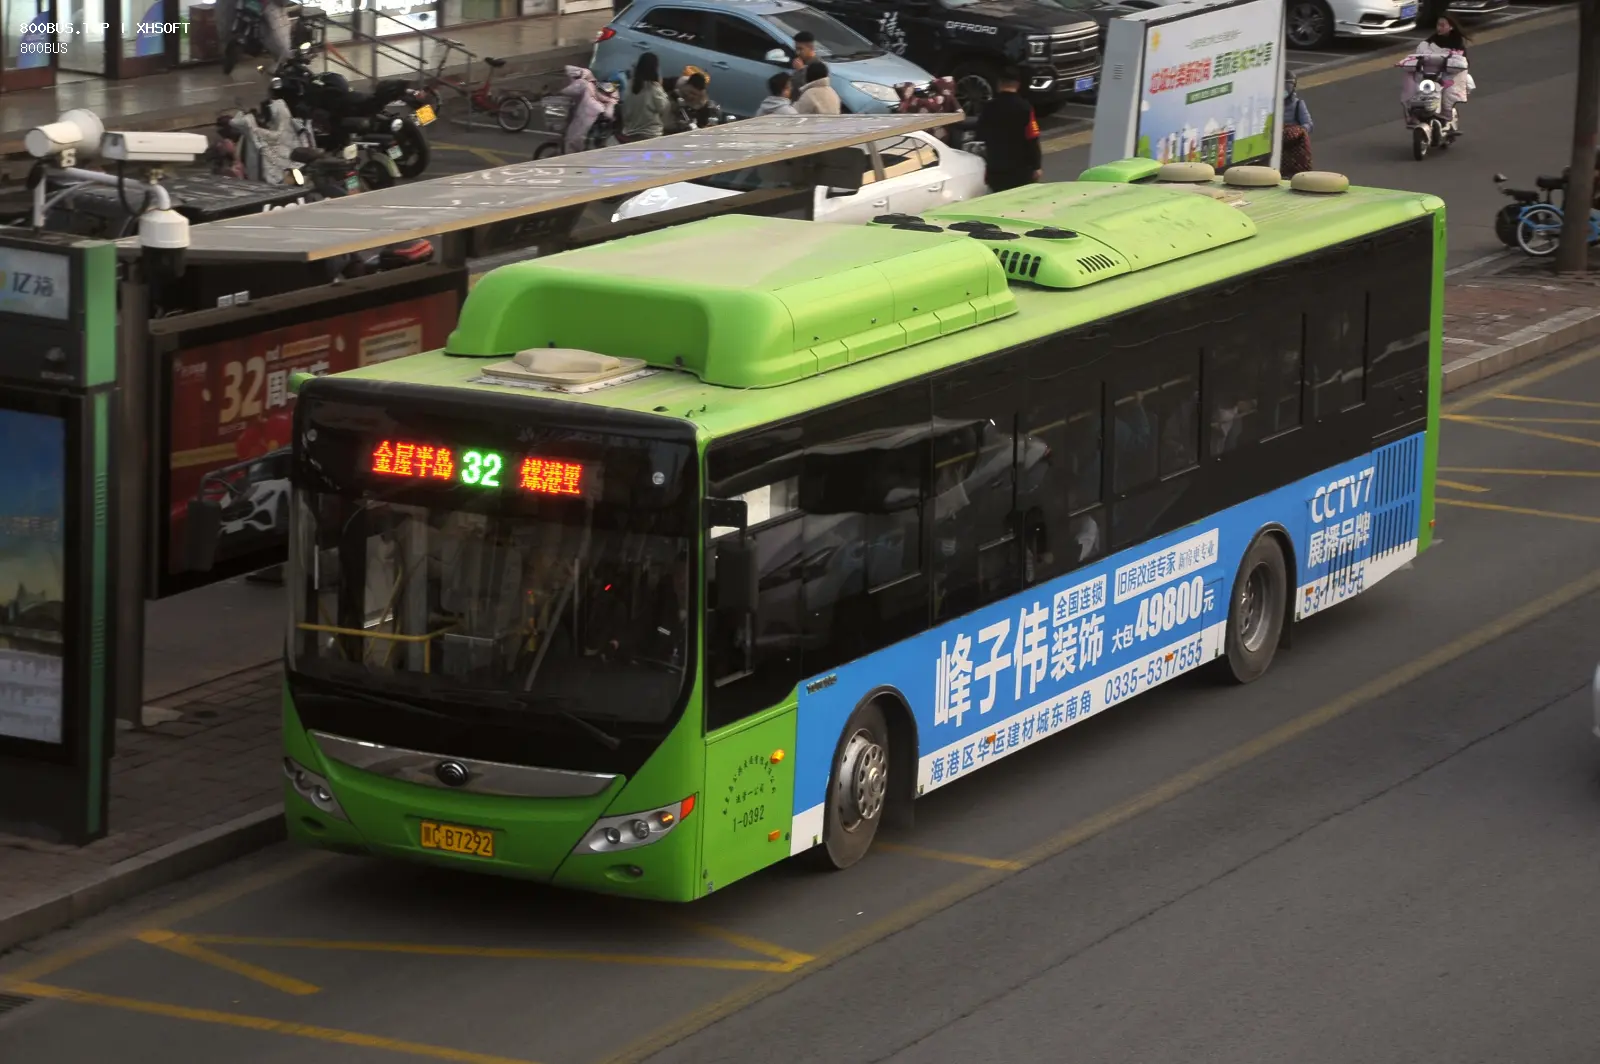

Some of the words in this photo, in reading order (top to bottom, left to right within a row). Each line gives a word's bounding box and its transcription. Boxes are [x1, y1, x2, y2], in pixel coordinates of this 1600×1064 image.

[945, 20, 998, 35] OFFROAD
[218, 356, 266, 424] 32
[372, 440, 454, 480] 金屋半岛
[460, 449, 502, 488] 32
[1311, 465, 1376, 524] CCTV7
[1308, 511, 1371, 569] 展播品牌
[1117, 550, 1177, 597] 旧房改造专家
[1055, 579, 1104, 622] 全国连锁
[933, 600, 1050, 728] 峰子伟
[1050, 613, 1106, 682] 装饰
[1103, 638, 1203, 705] 0335-5317555
[930, 689, 1093, 786] 海港区华运建材城东南角
[733, 804, 765, 832] 1-0392
